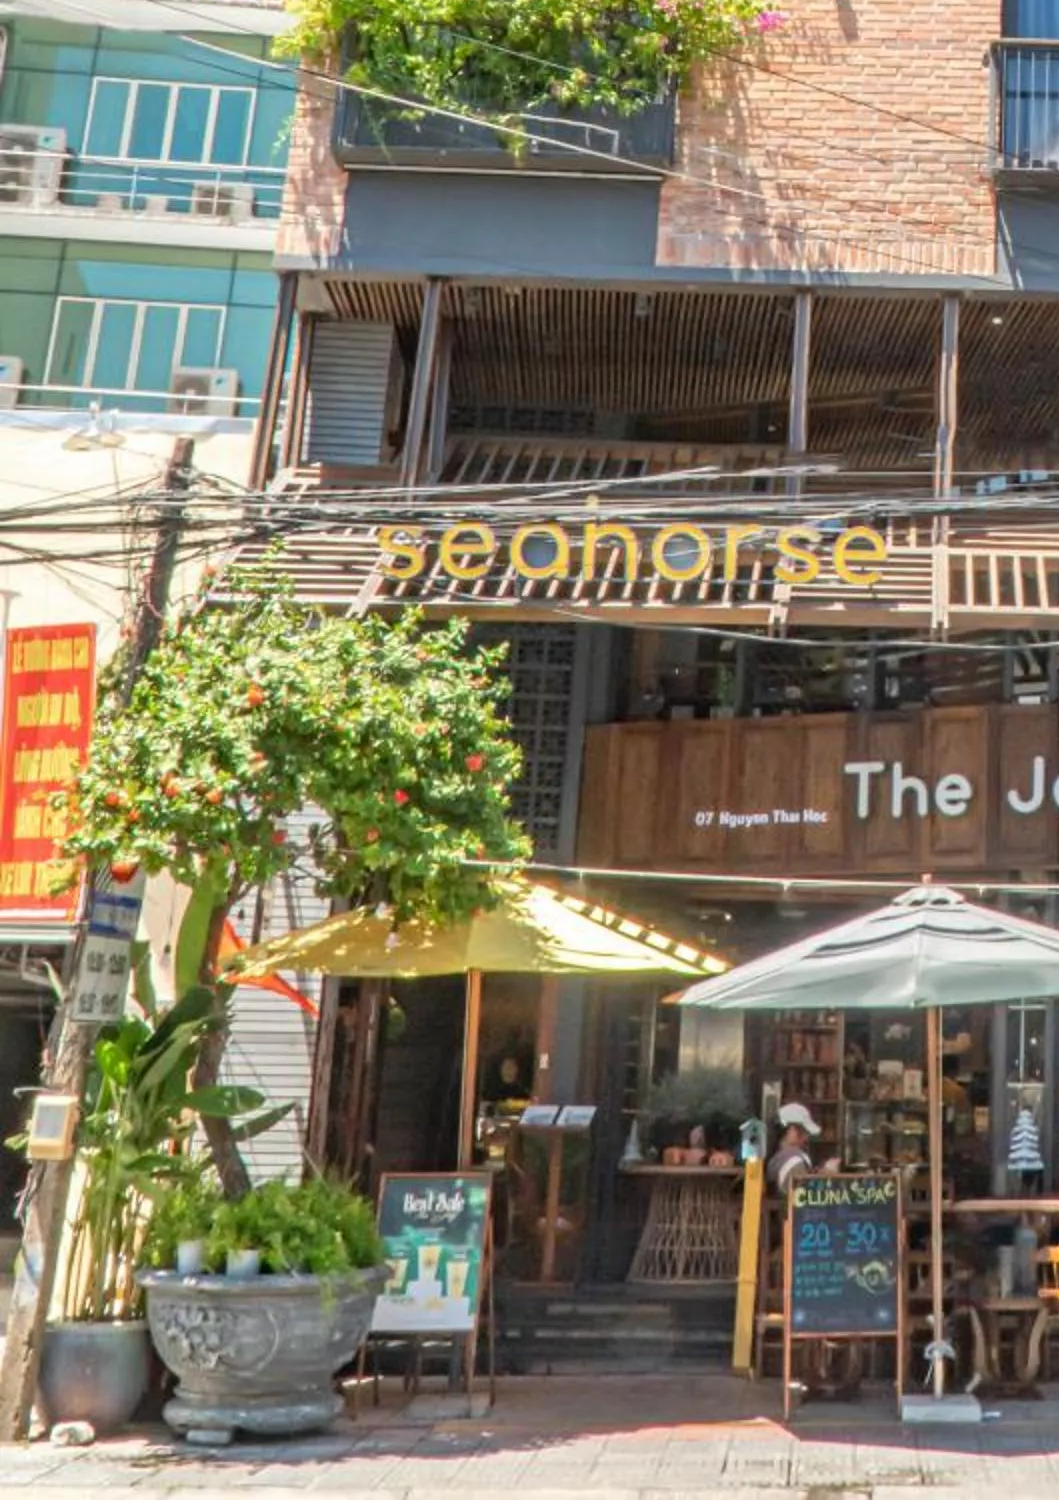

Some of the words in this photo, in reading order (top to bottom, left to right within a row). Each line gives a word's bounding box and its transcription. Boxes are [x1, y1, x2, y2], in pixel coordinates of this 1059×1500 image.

[377, 493, 888, 585] seahorse
[844, 761, 973, 818] The
[695, 811, 714, 826] 07
